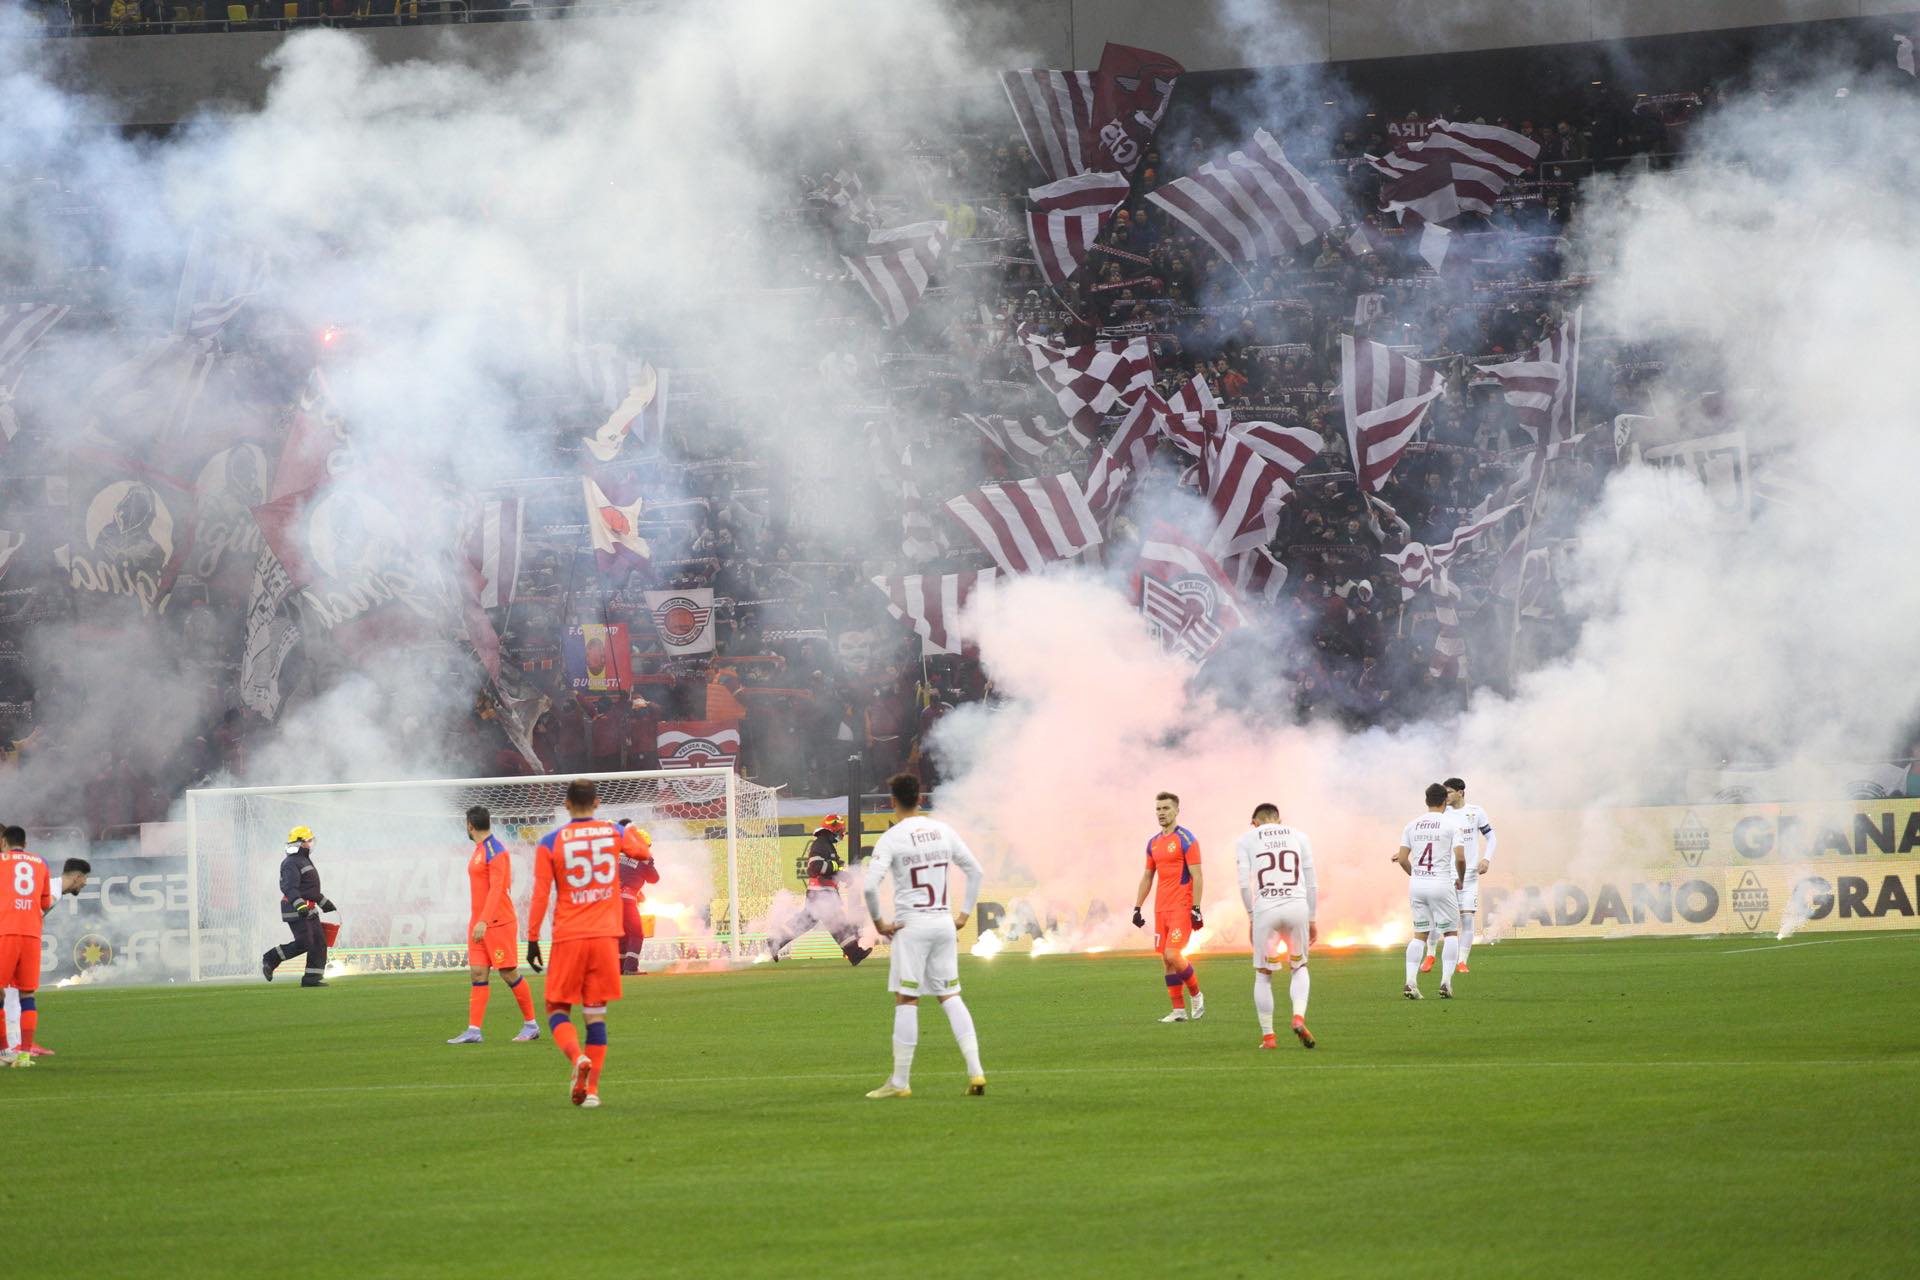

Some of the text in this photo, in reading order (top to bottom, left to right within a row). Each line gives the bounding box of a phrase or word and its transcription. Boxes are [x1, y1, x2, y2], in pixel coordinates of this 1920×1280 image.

[12, 853, 43, 864] BETANO
[563, 836, 616, 888] 55
[1255, 849, 1300, 889] 29
[1418, 842, 1434, 872] 4
[14, 861, 35, 896] 8
[910, 862, 949, 908] 57
[1270, 888, 1293, 897] DSC
[1792, 874, 1920, 920] GRA
[15, 898, 33, 910] SUT
[1481, 879, 1720, 927] PADANO
